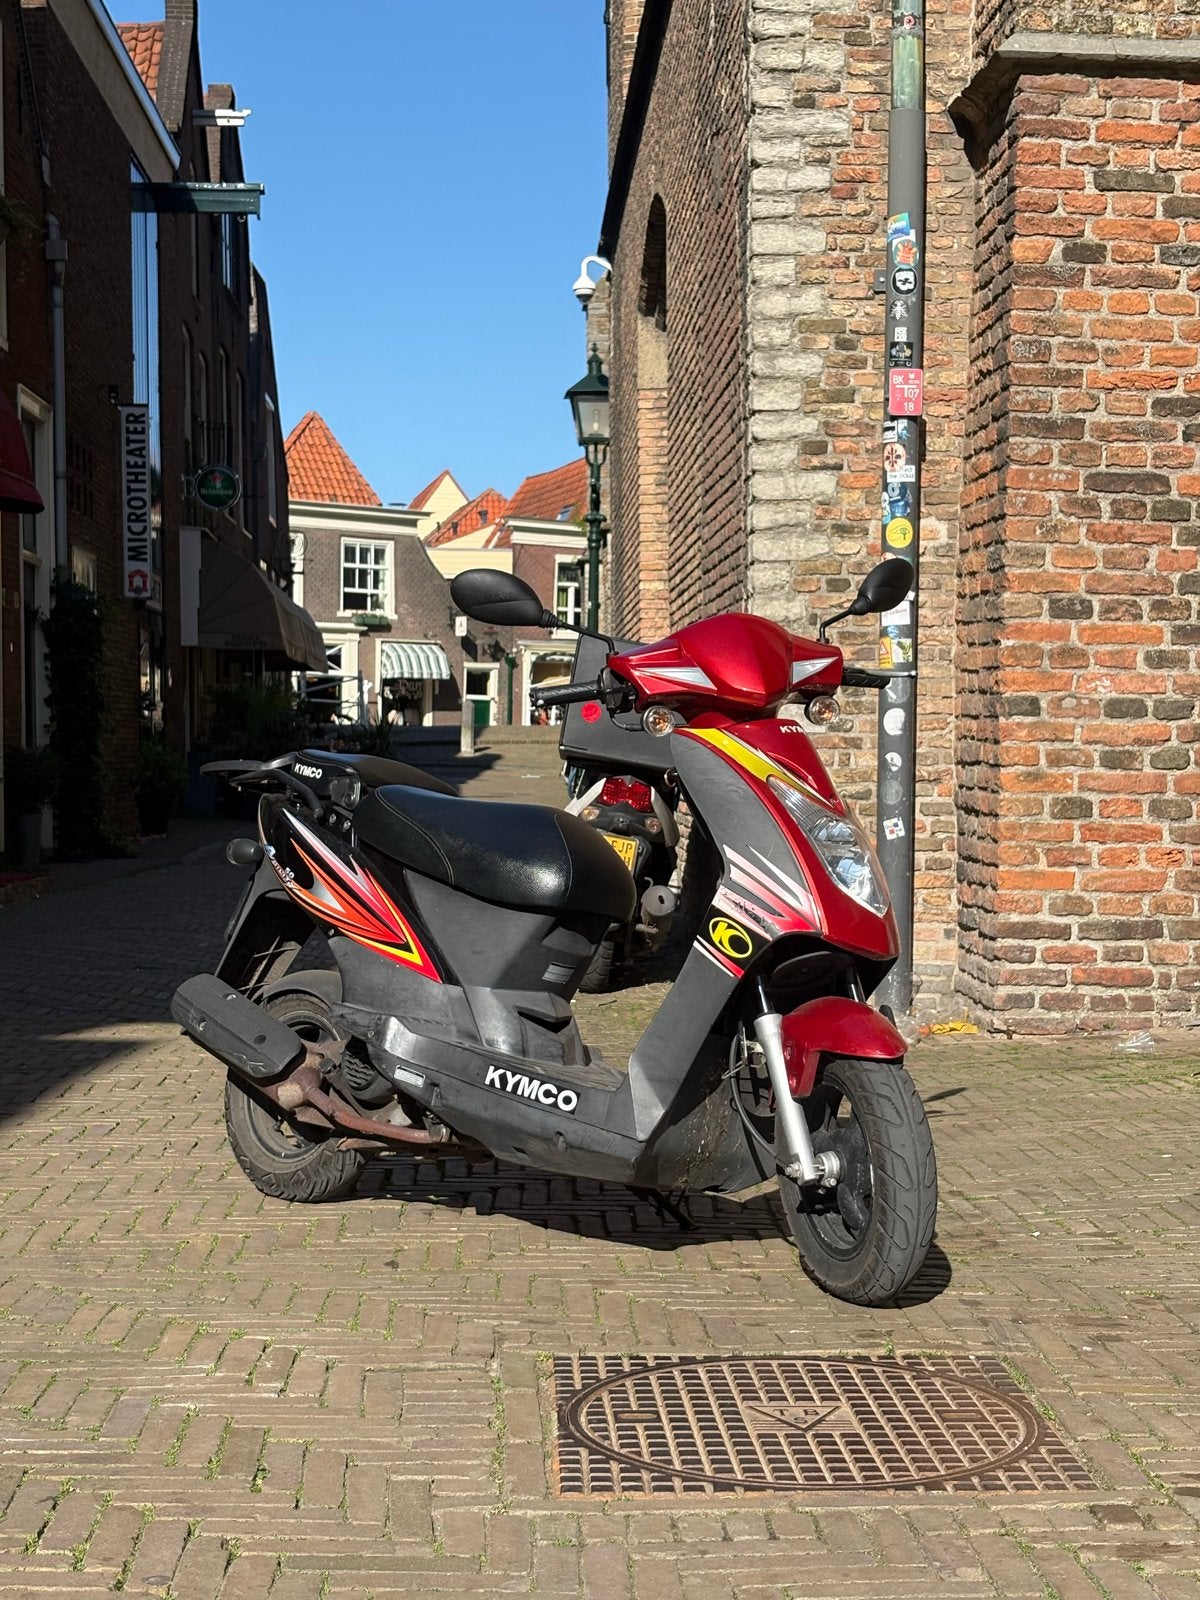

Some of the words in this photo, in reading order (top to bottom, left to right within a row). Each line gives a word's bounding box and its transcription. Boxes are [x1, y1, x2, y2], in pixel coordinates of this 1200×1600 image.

[893, 374, 904, 384] BK
[908, 389, 920, 398] 07
[904, 402, 914, 411] 18
[125, 412, 148, 562] MICROTHEATER
[294, 762, 322, 779] KYMCO
[484, 1065, 578, 1112] KYMCO
